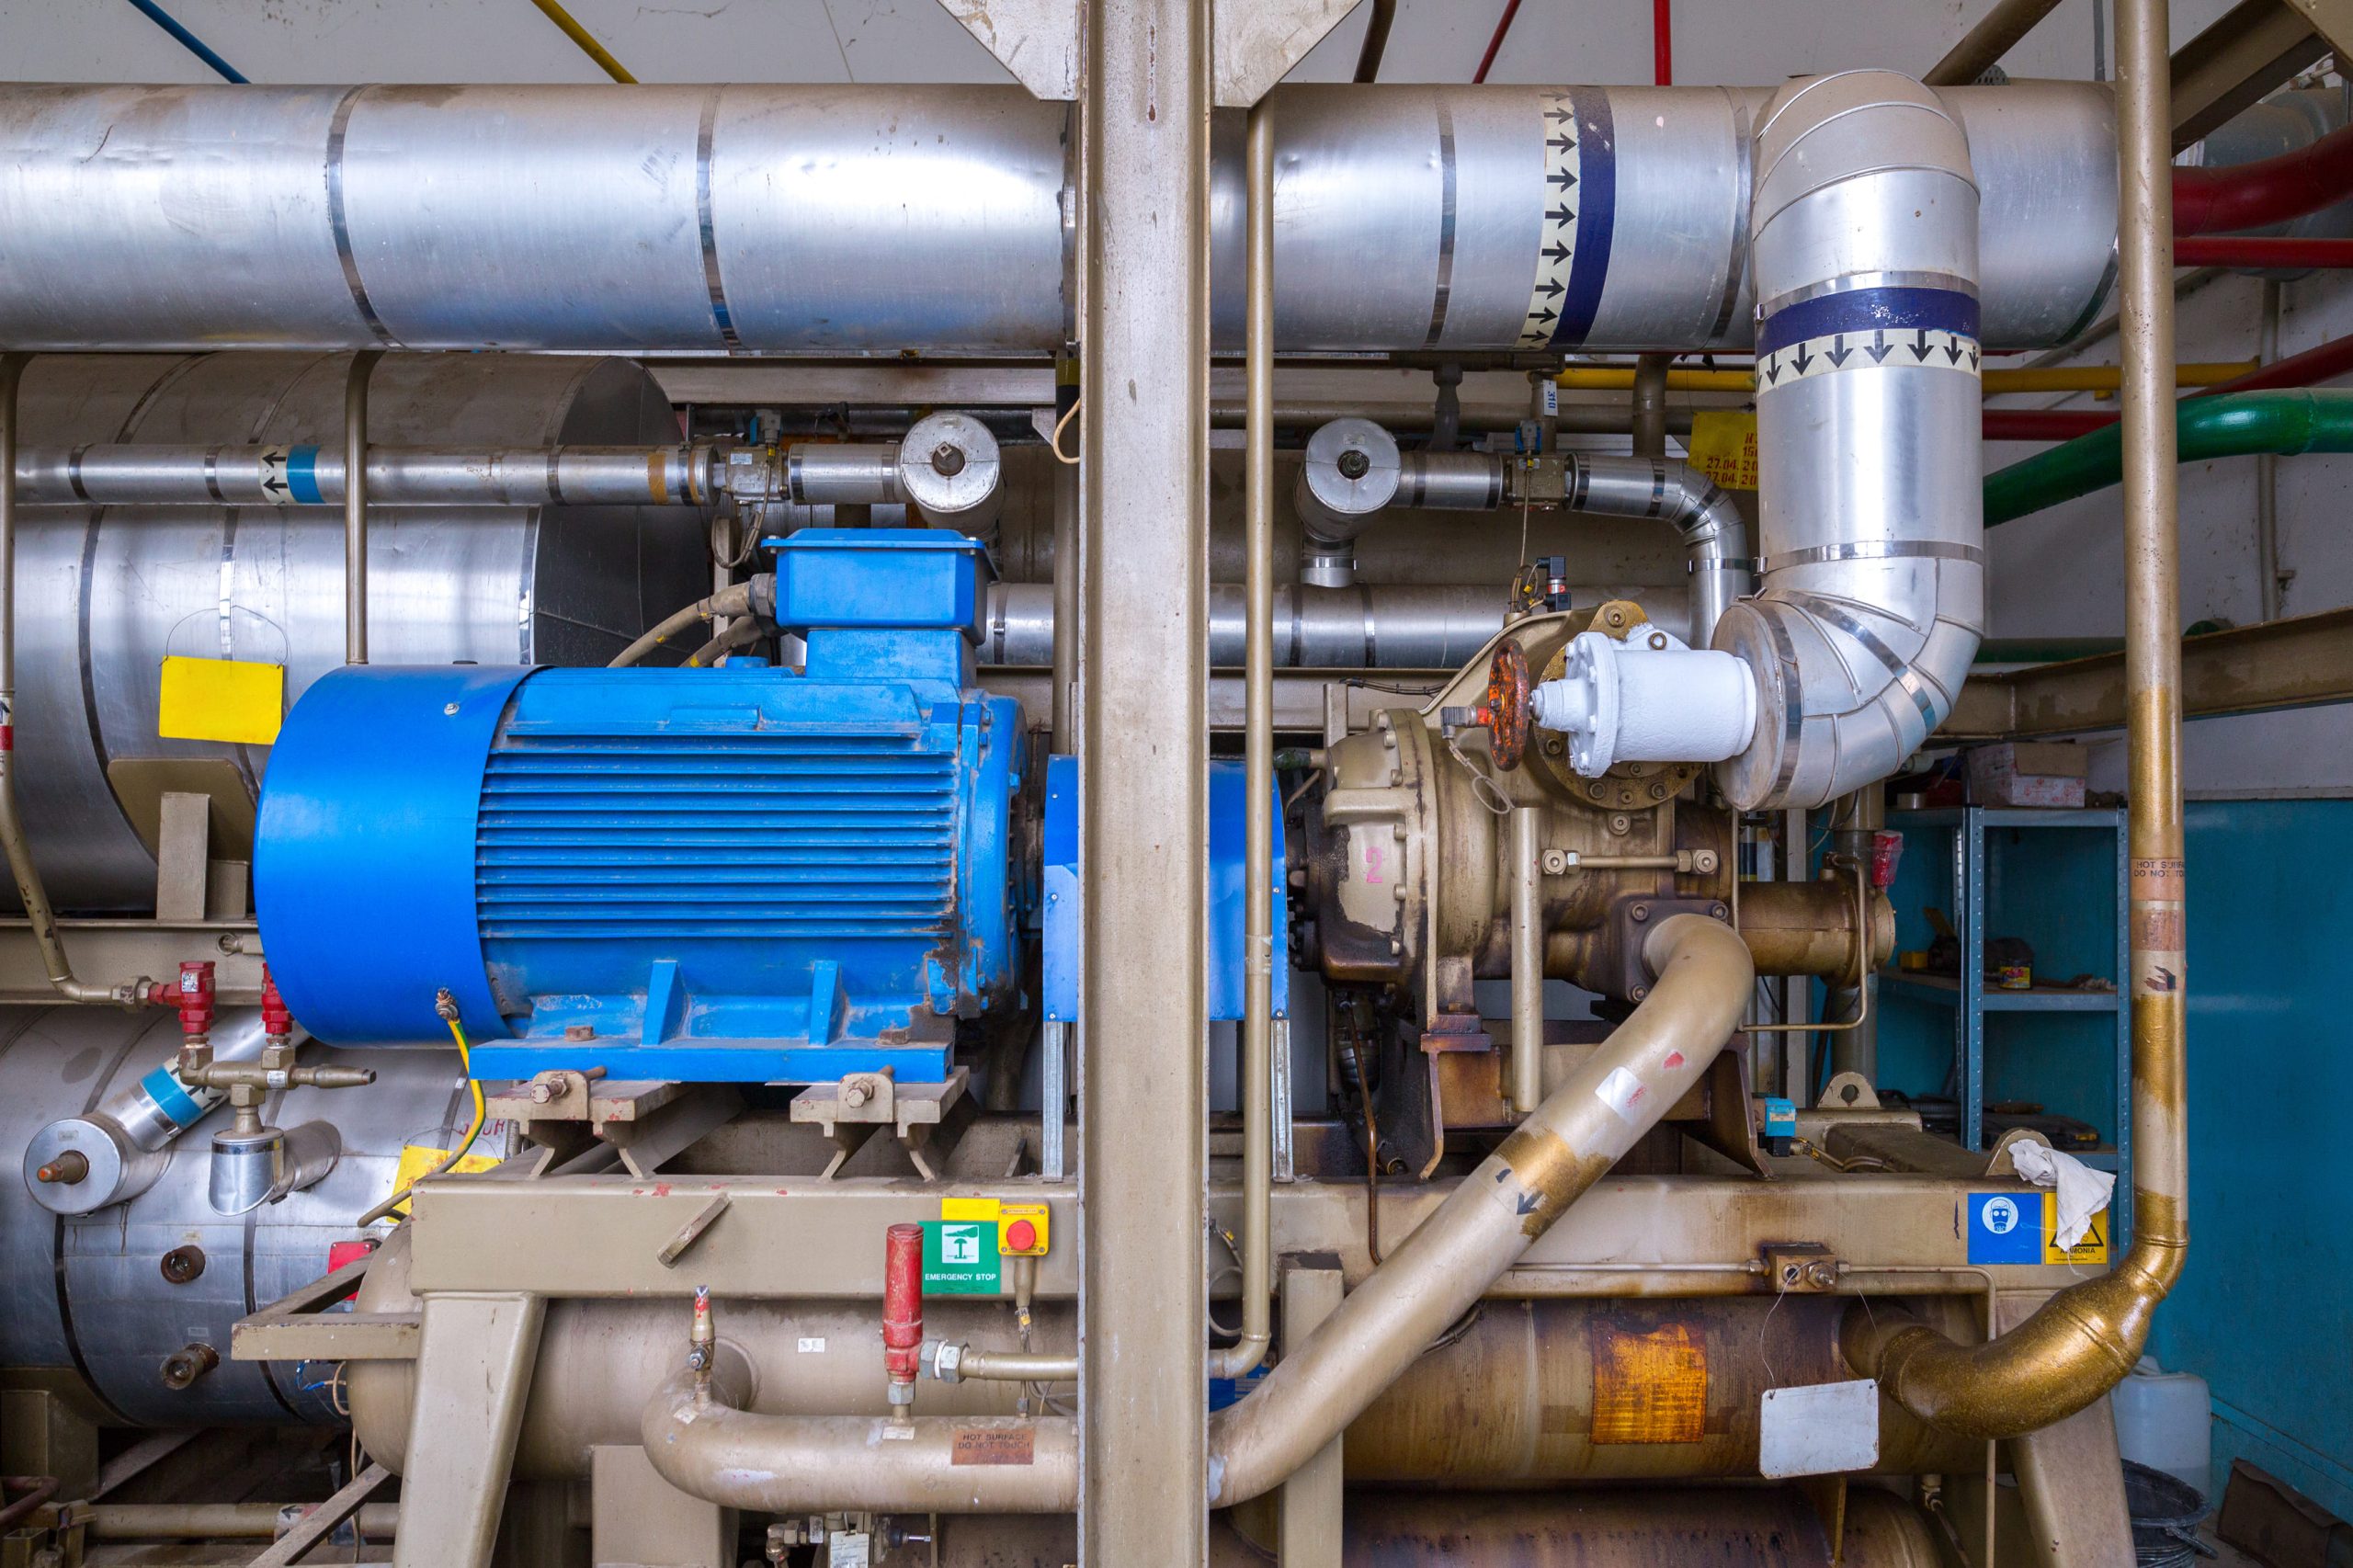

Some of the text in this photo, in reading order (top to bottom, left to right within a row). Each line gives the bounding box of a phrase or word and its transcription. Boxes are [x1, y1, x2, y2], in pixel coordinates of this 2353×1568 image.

[1366, 846, 1383, 883] 2
[925, 1273, 996, 1281] EMERGENCY STOP
[986, 1433, 1028, 1441] SURFACE
[958, 1441, 1030, 1449] DO NOT TOUCH
